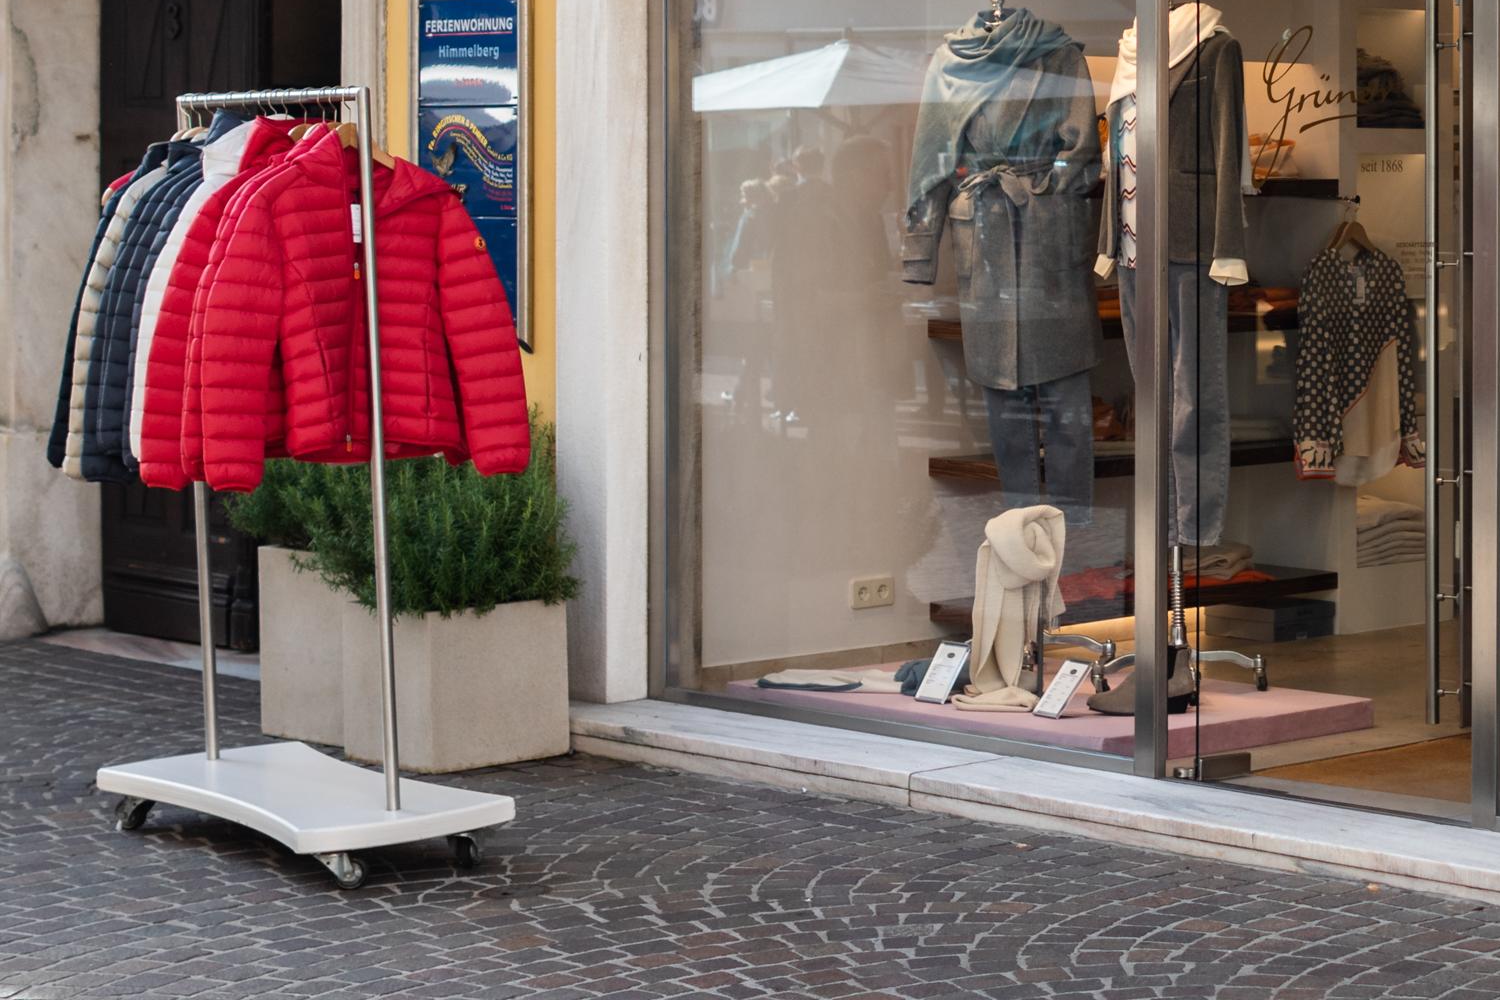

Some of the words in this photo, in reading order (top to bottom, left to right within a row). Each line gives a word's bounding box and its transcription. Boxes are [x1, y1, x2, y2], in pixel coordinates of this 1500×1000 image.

[424, 17, 514, 34] FERIENWOHNUNG
[438, 44, 500, 60] Himmelberg
[1360, 159, 1378, 173] seit
[1380, 159, 1404, 174] 1868
